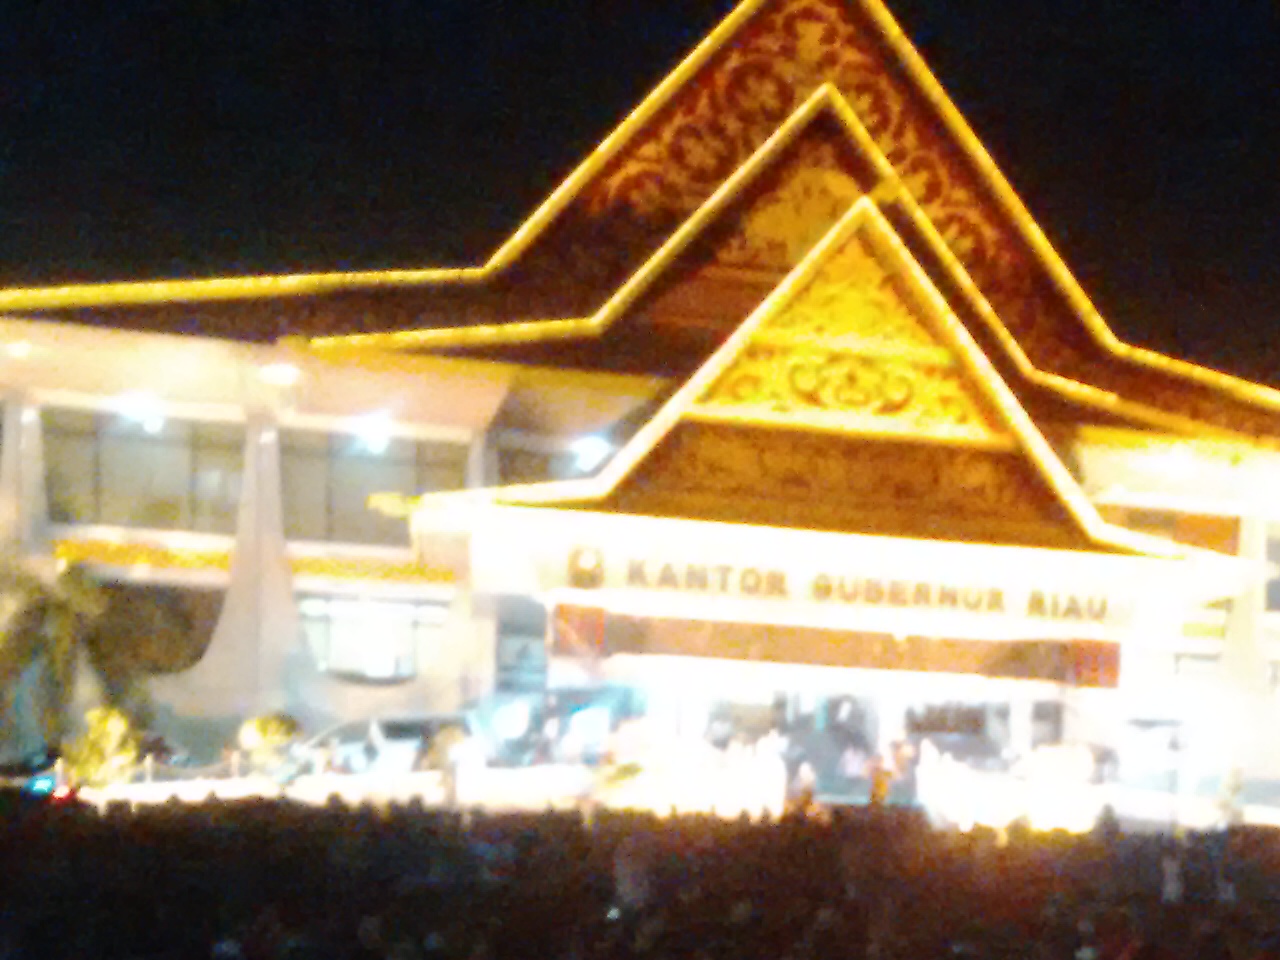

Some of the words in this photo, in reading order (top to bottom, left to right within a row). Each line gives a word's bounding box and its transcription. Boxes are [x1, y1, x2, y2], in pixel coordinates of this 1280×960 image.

[626, 558, 790, 599] KANTOR
[811, 572, 1006, 614] GUBERNUR
[1026, 588, 1109, 623] RIAU
